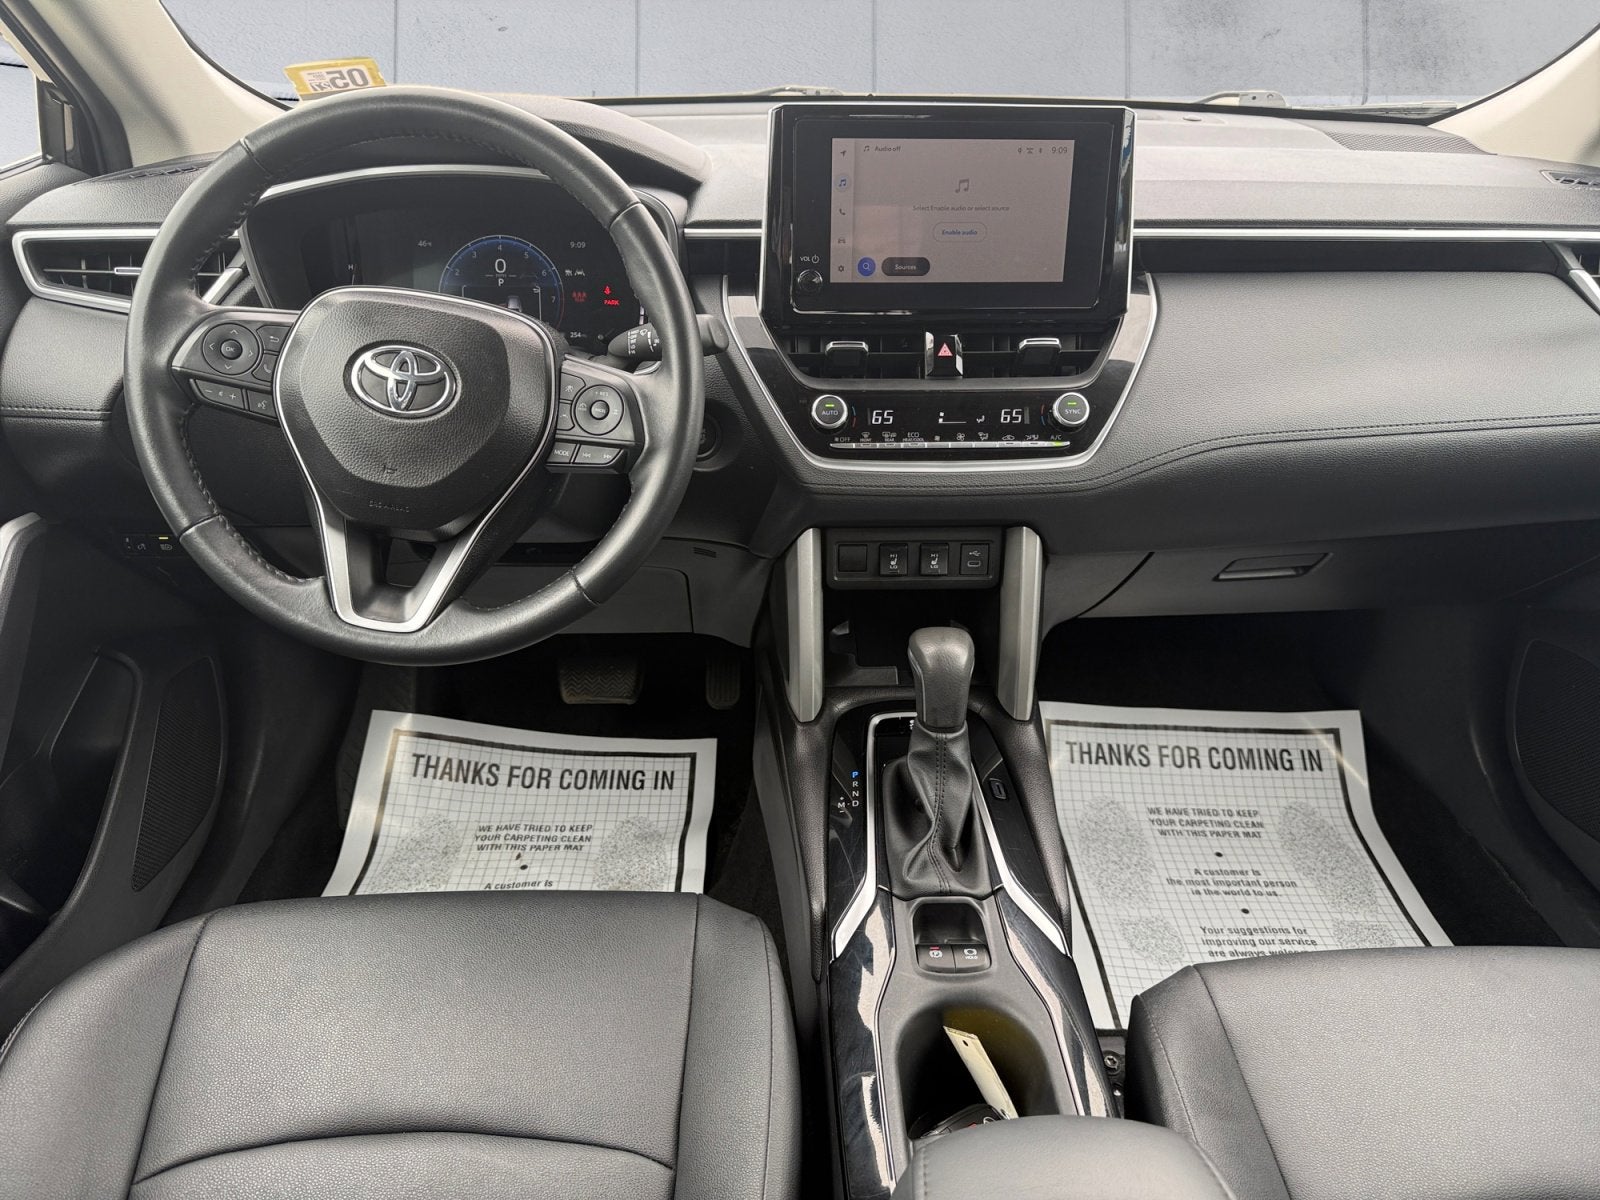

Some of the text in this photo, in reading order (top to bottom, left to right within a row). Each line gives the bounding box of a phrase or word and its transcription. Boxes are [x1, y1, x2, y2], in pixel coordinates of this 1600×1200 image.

[1051, 146, 1068, 154] 9:09
[497, 244, 503, 252] 4
[570, 241, 587, 249] 9:09
[471, 251, 477, 259] 3
[523, 251, 529, 259] 5
[494, 258, 507, 274] 0
[541, 269, 548, 277] 6
[498, 278, 505, 287] P
[871, 409, 894, 425] 65
[1000, 408, 1022, 424] 65
[554, 449, 570, 457] MODE
[1065, 741, 1323, 772] THANKS FOR COMING IN
[412, 753, 675, 791] THANKS FOR COMING IN
[852, 771, 859, 779] P
[852, 780, 859, 788] R
[852, 790, 859, 798] N
[837, 801, 846, 809] M
[1147, 807, 1259, 818] WE HAVE TRIED TO KEEP
[1149, 818, 1264, 829] YOUR CARPETING CLEAN
[478, 824, 593, 833] WE HAVE TRIED TO KEEP
[474, 833, 593, 843] YOUR CARPETING CLEAN
[1158, 829, 1262, 839] WITH THIS PAPER MAT
[476, 843, 501, 852] WITH
[505, 844, 527, 852] THIS
[563, 844, 585, 852] MAT
[1193, 868, 1261, 876] A customer is
[483, 879, 554, 890] A customer is
[1166, 878, 1298, 888] the most important person
[1191, 888, 1202, 896] in
[1203, 888, 1220, 896] the
[1222, 889, 1251, 897] world
[1252, 889, 1264, 897] to
[1200, 925, 1309, 936] Your suggestions for
[1201, 937, 1257, 947] improving
[1278, 938, 1319, 947] service
[1208, 949, 1227, 958] are
[1228, 948, 1266, 958] always
